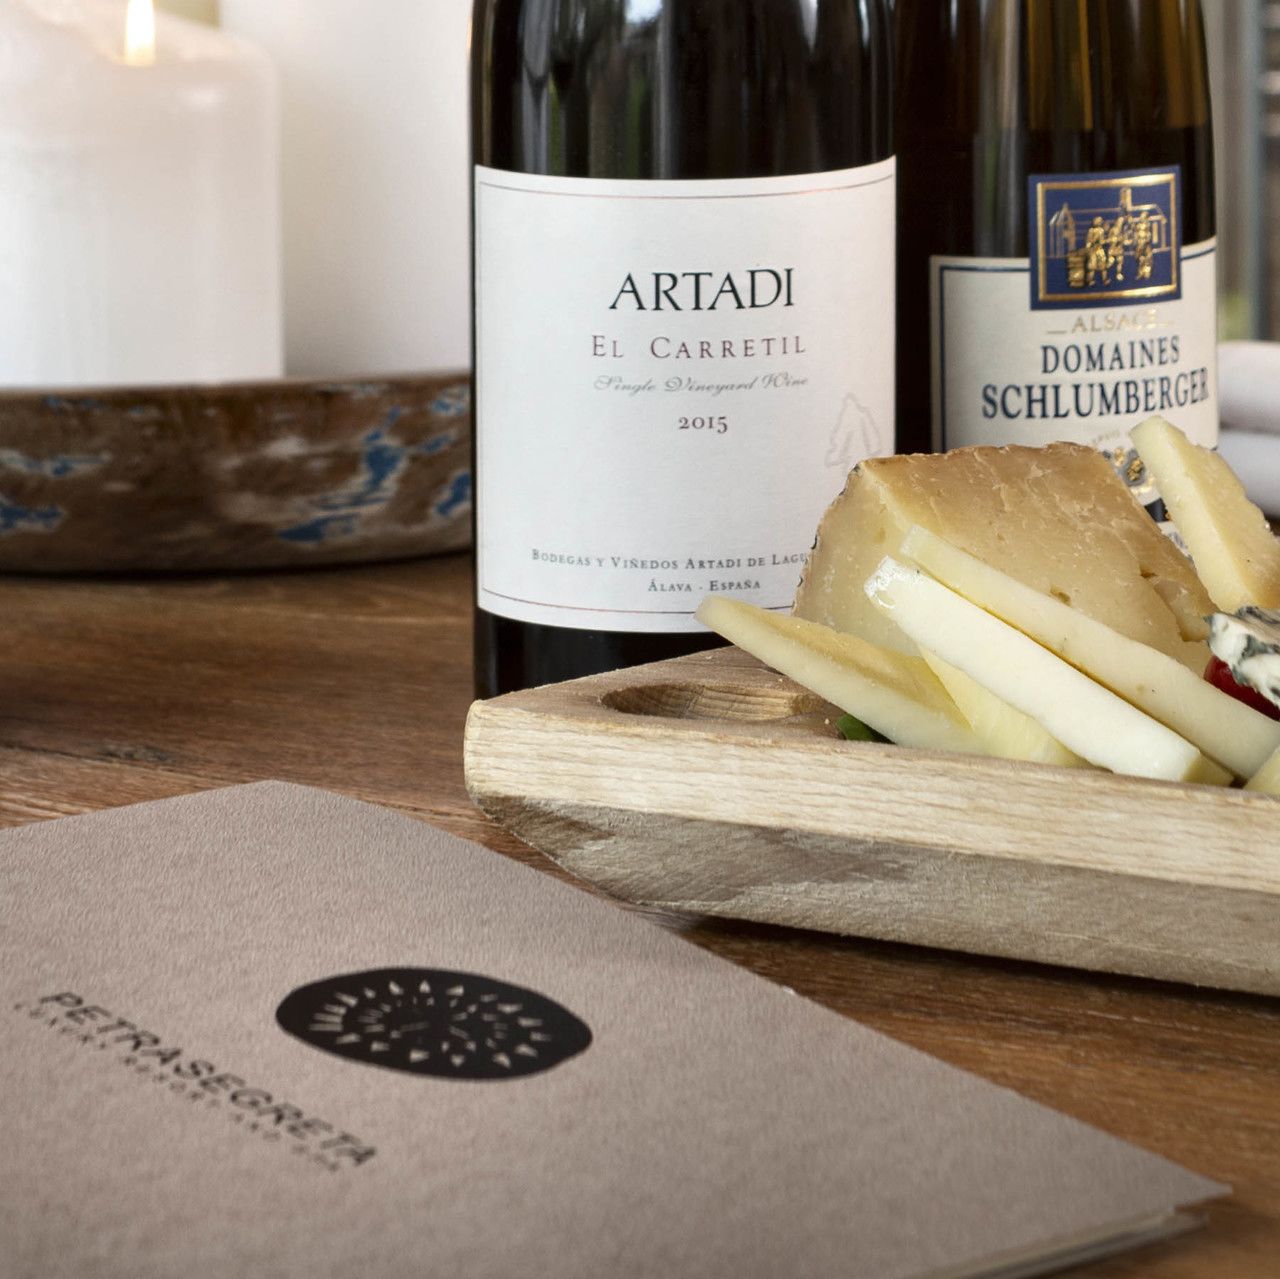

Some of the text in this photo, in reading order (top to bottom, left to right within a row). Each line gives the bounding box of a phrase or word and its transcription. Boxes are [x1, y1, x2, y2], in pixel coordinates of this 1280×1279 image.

[608, 268, 795, 311] ARTADI
[650, 335, 806, 359] CARRETIL
[1041, 335, 1180, 374] DOMAINES
[593, 375, 656, 397] Single
[981, 367, 1209, 420] SCHLUMBERGER
[678, 416, 729, 434] 2015
[38, 991, 378, 1167] PETRASEGRETA
